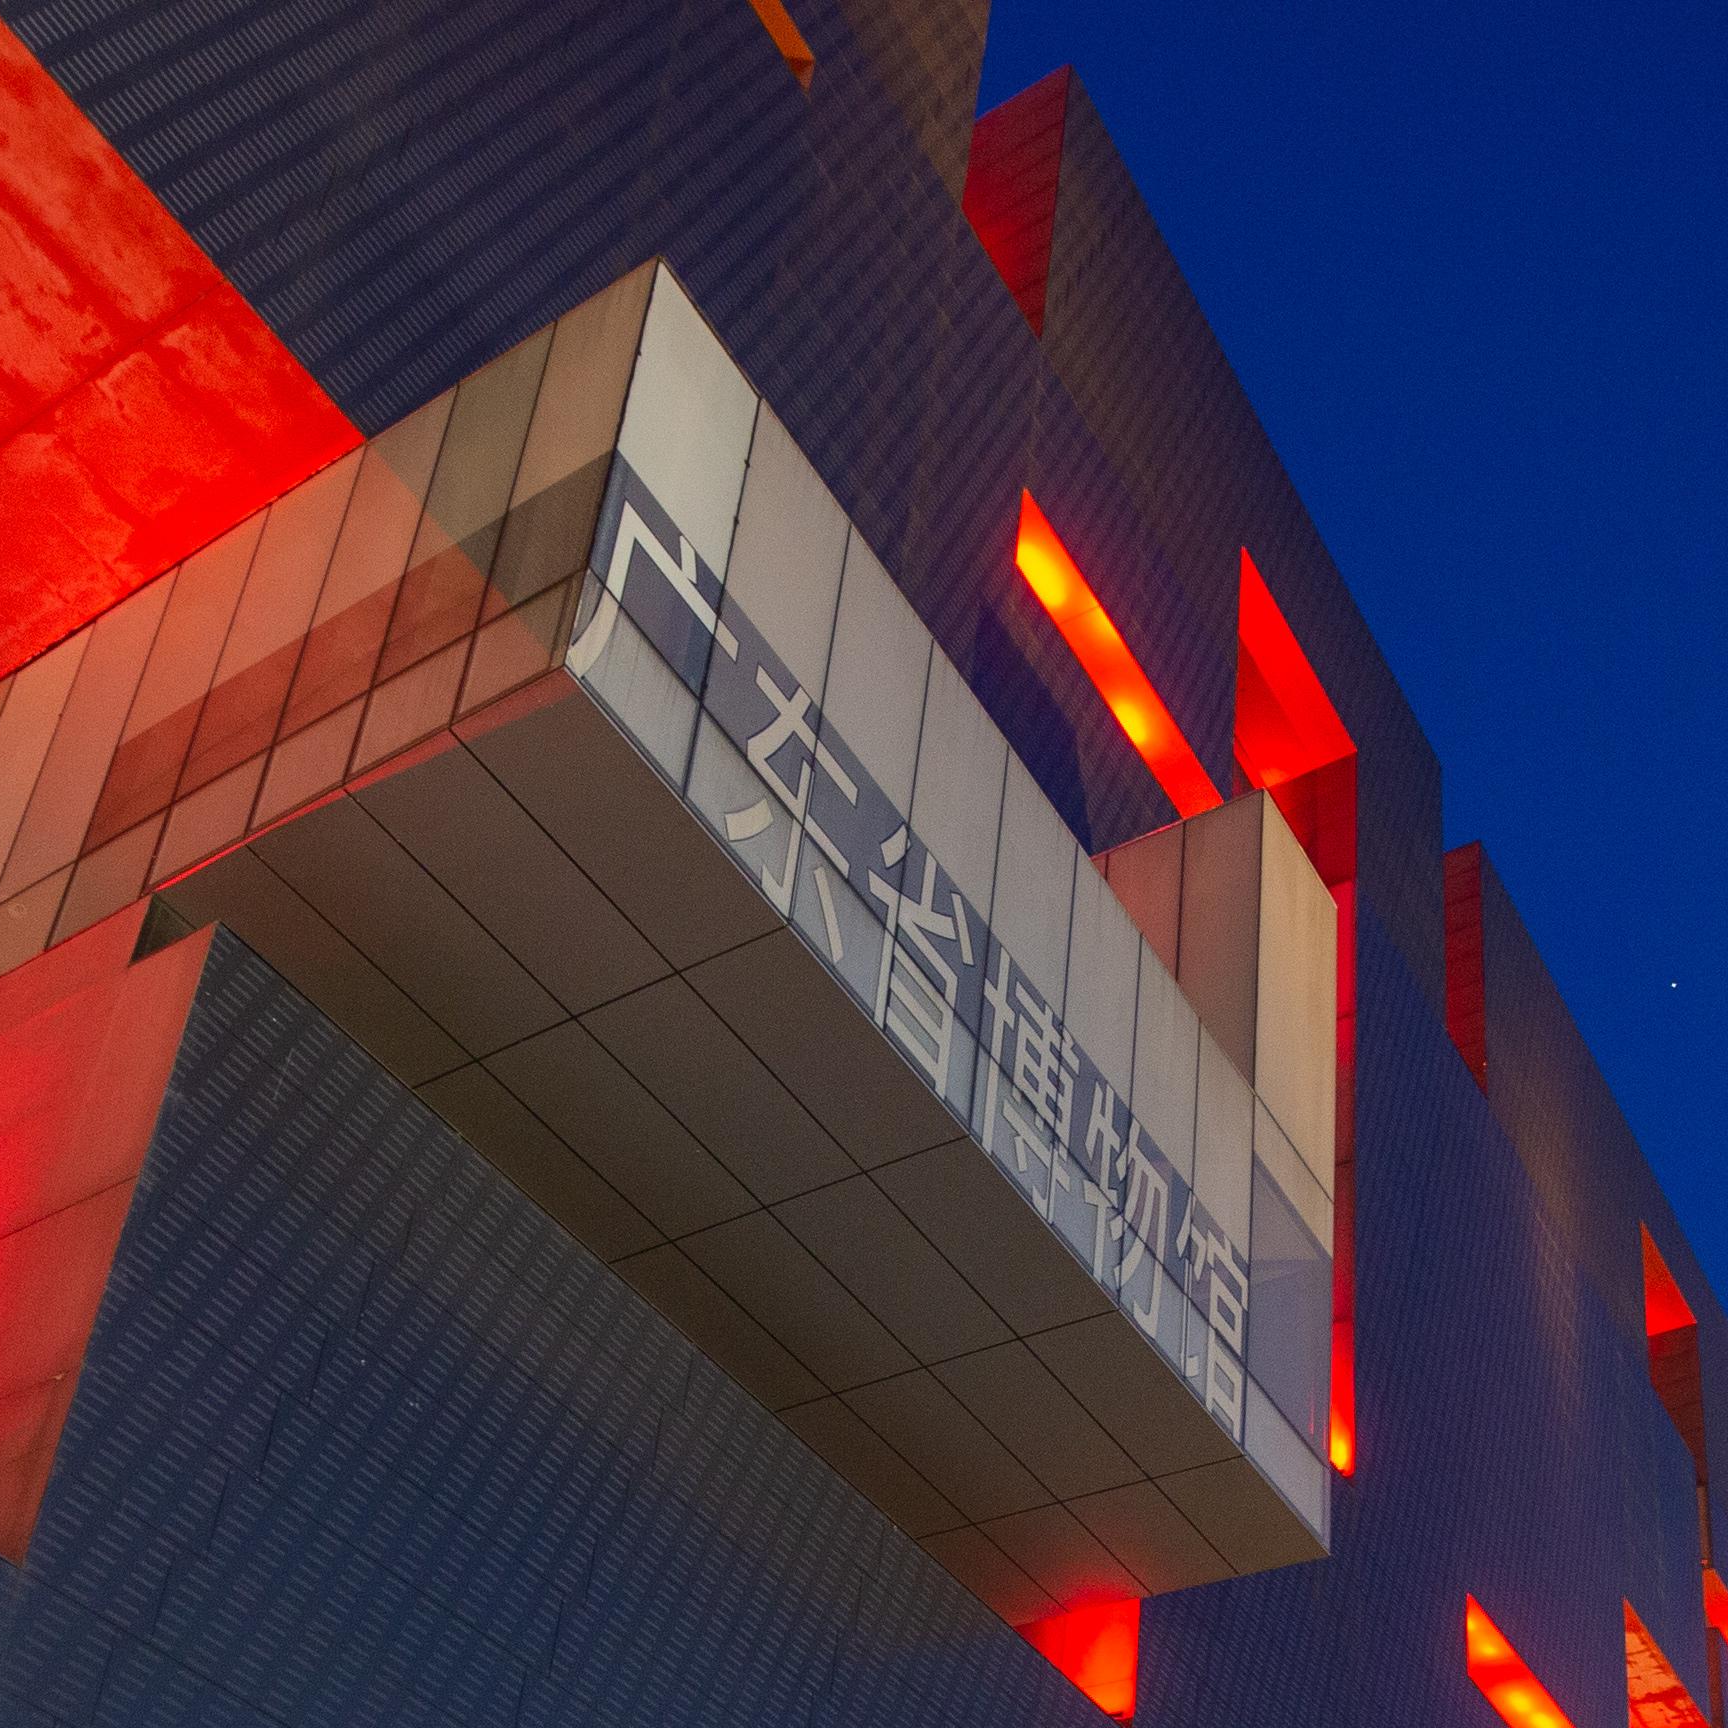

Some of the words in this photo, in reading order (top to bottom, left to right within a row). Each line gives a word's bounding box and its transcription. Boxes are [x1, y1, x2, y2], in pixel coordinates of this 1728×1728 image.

[566, 500, 1250, 1442] 广东省博物馆
